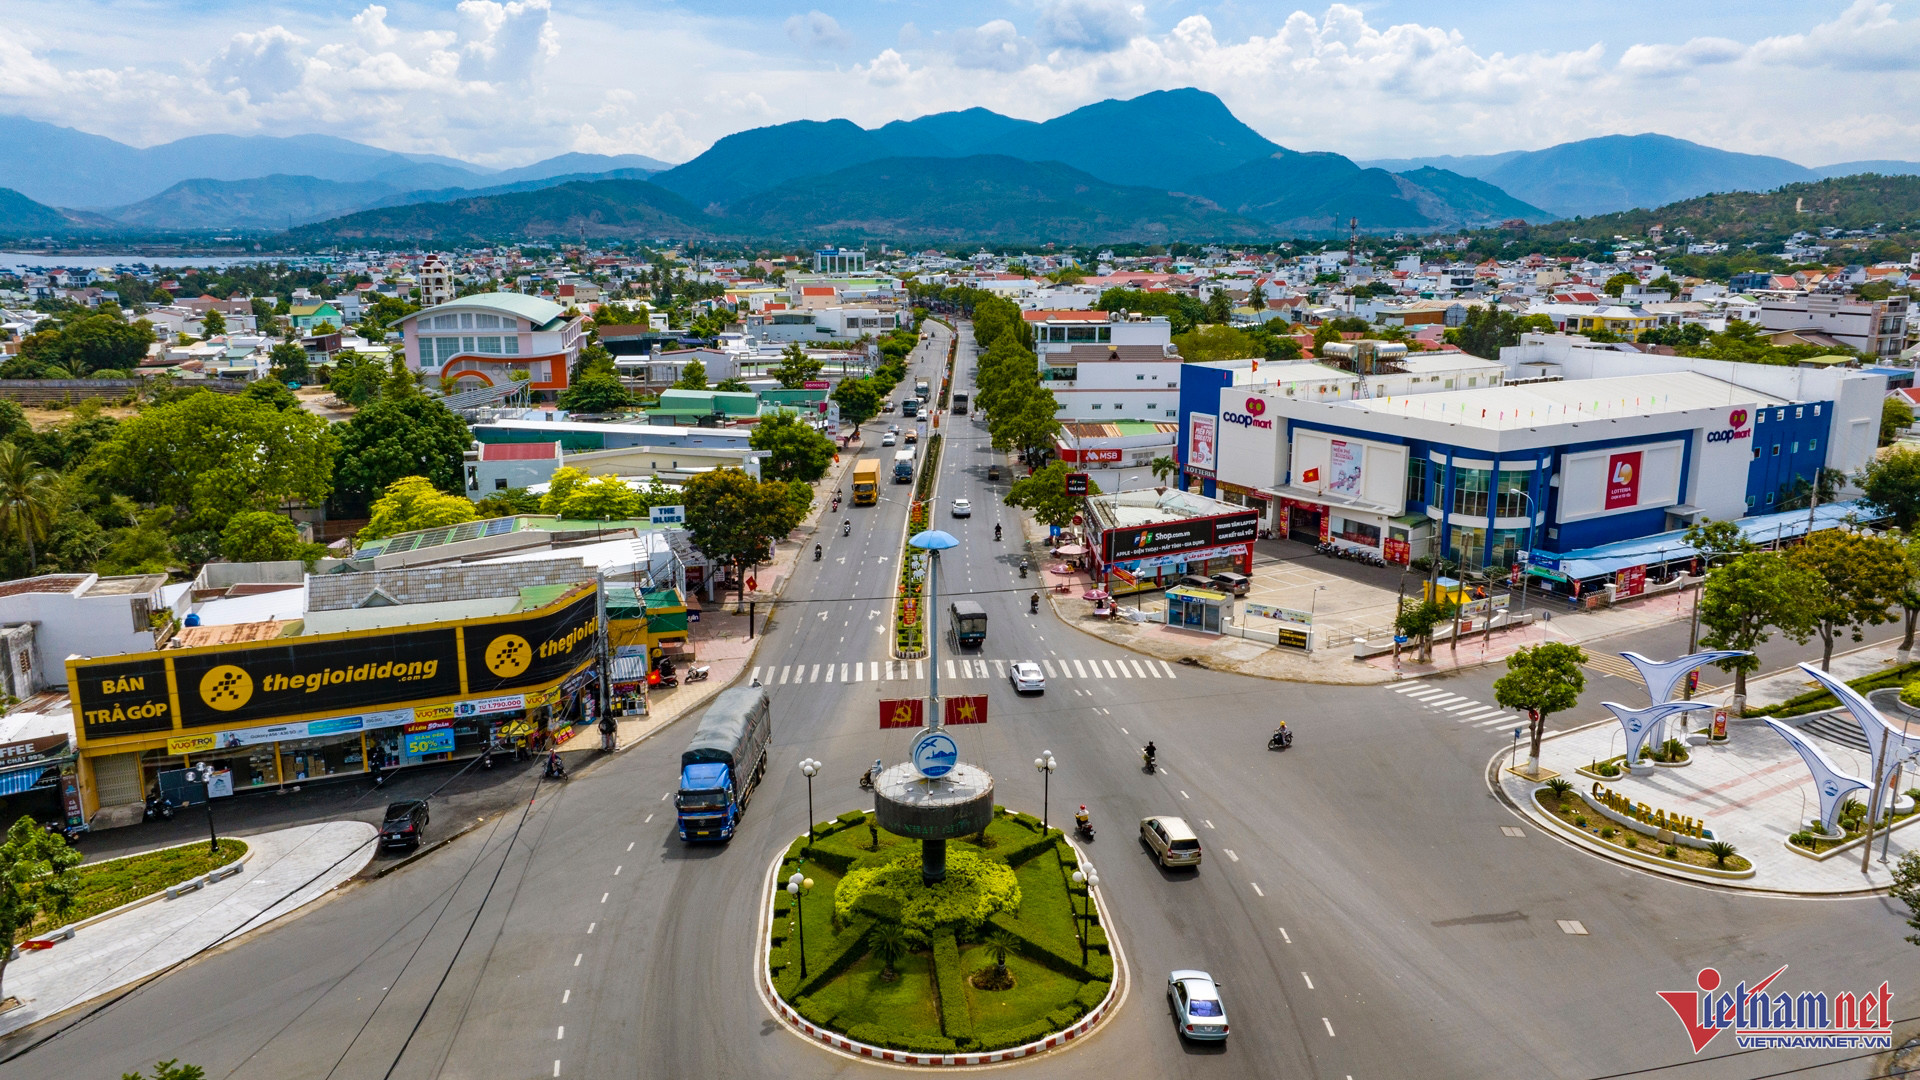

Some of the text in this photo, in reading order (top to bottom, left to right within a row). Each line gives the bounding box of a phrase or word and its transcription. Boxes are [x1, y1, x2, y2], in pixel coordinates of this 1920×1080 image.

[1100, 452, 1118, 460] MSB
[1186, 466, 1216, 478] LOTTERIA
[1611, 487, 1631, 495] LOTTERIA
[657, 507, 676, 515] THE
[652, 515, 682, 524] BLUES
[1133, 531, 1191, 547] FPT Shop.com.vn
[262, 659, 439, 693] thegioididong
[101, 674, 145, 695] BÁN
[487, 699, 522, 709] 1.790.000
[85, 700, 168, 725] TRẢ GÓP
[409, 740, 438, 753] 50%
[1592, 781, 1703, 839] CAM RANH
